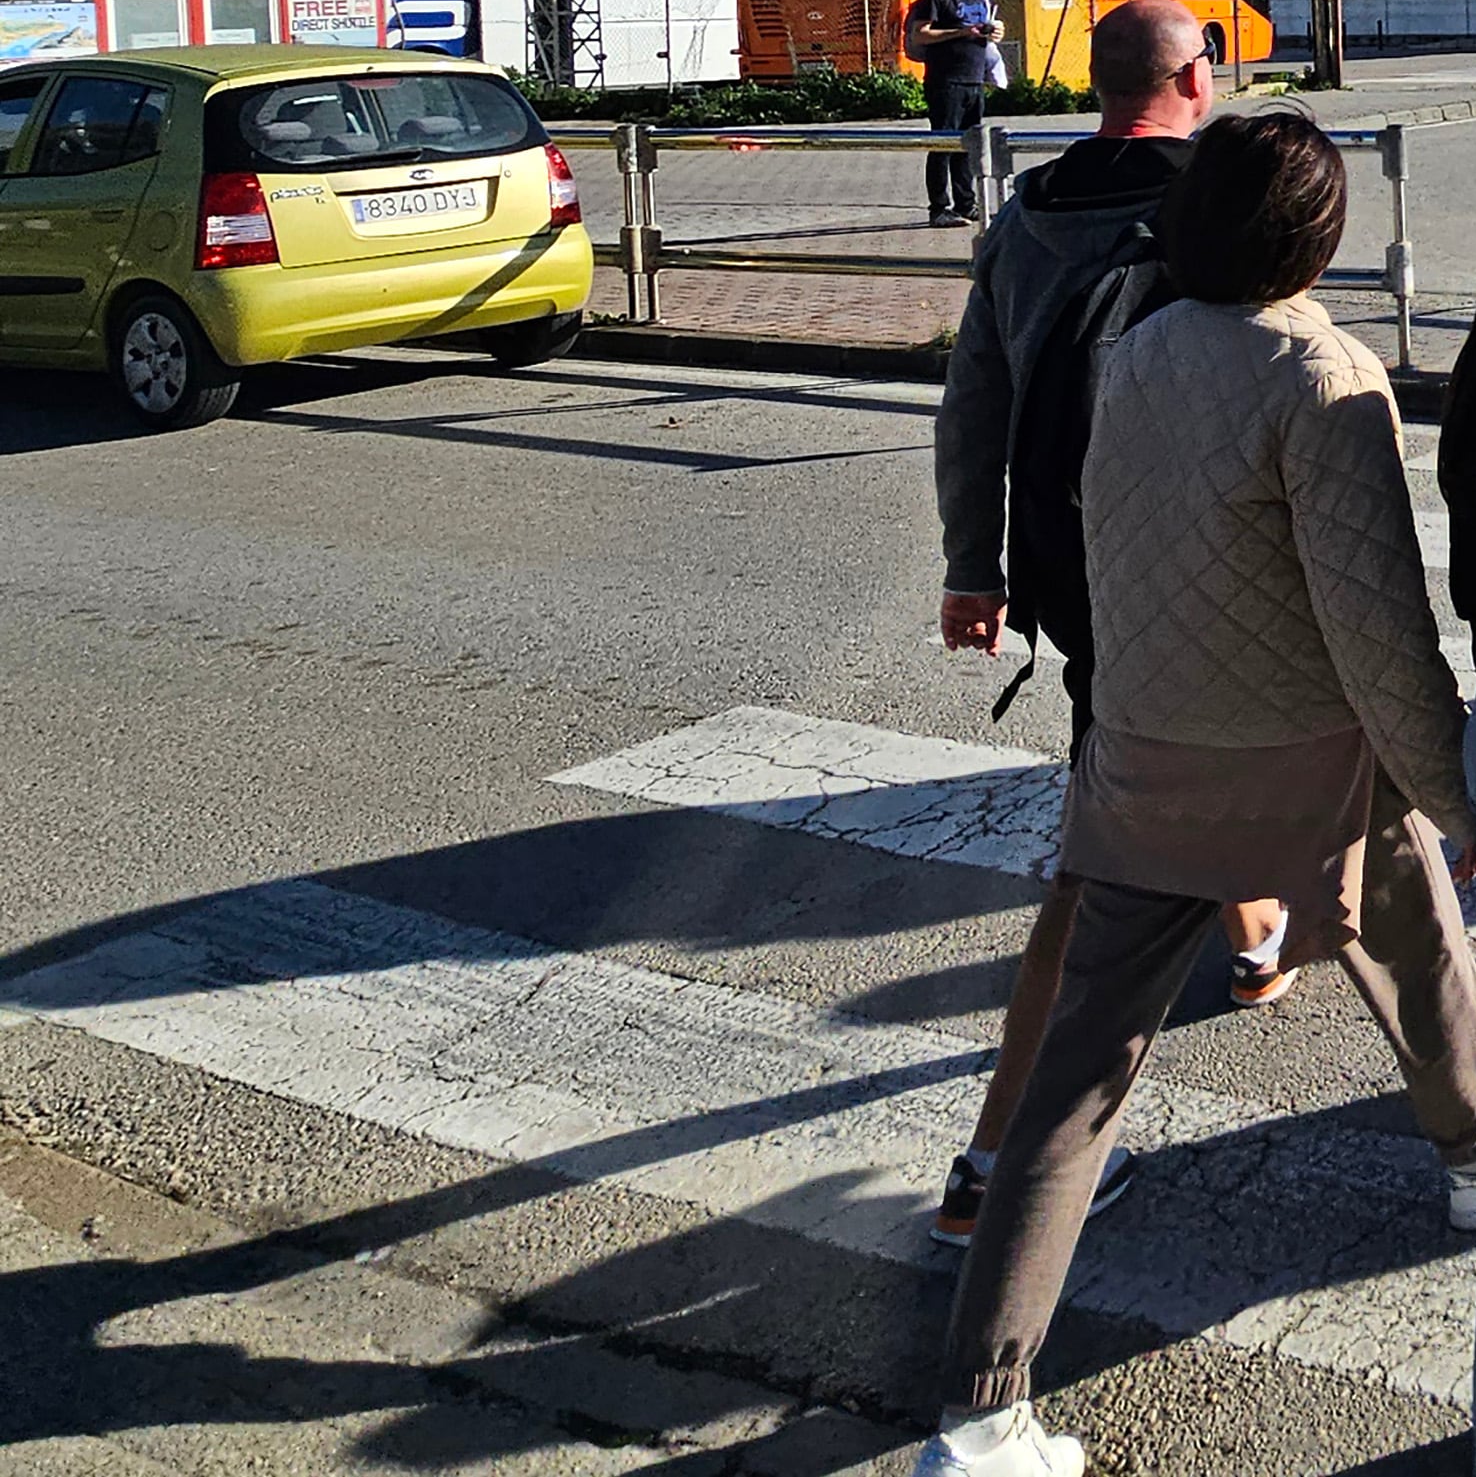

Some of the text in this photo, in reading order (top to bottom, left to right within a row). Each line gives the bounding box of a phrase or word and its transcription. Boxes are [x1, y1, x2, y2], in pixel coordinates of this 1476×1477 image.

[293, 0, 348, 18] FREE
[292, 16, 376, 31] DIRECT SHUTTLE
[368, 186, 477, 219] 8340 DYJ
